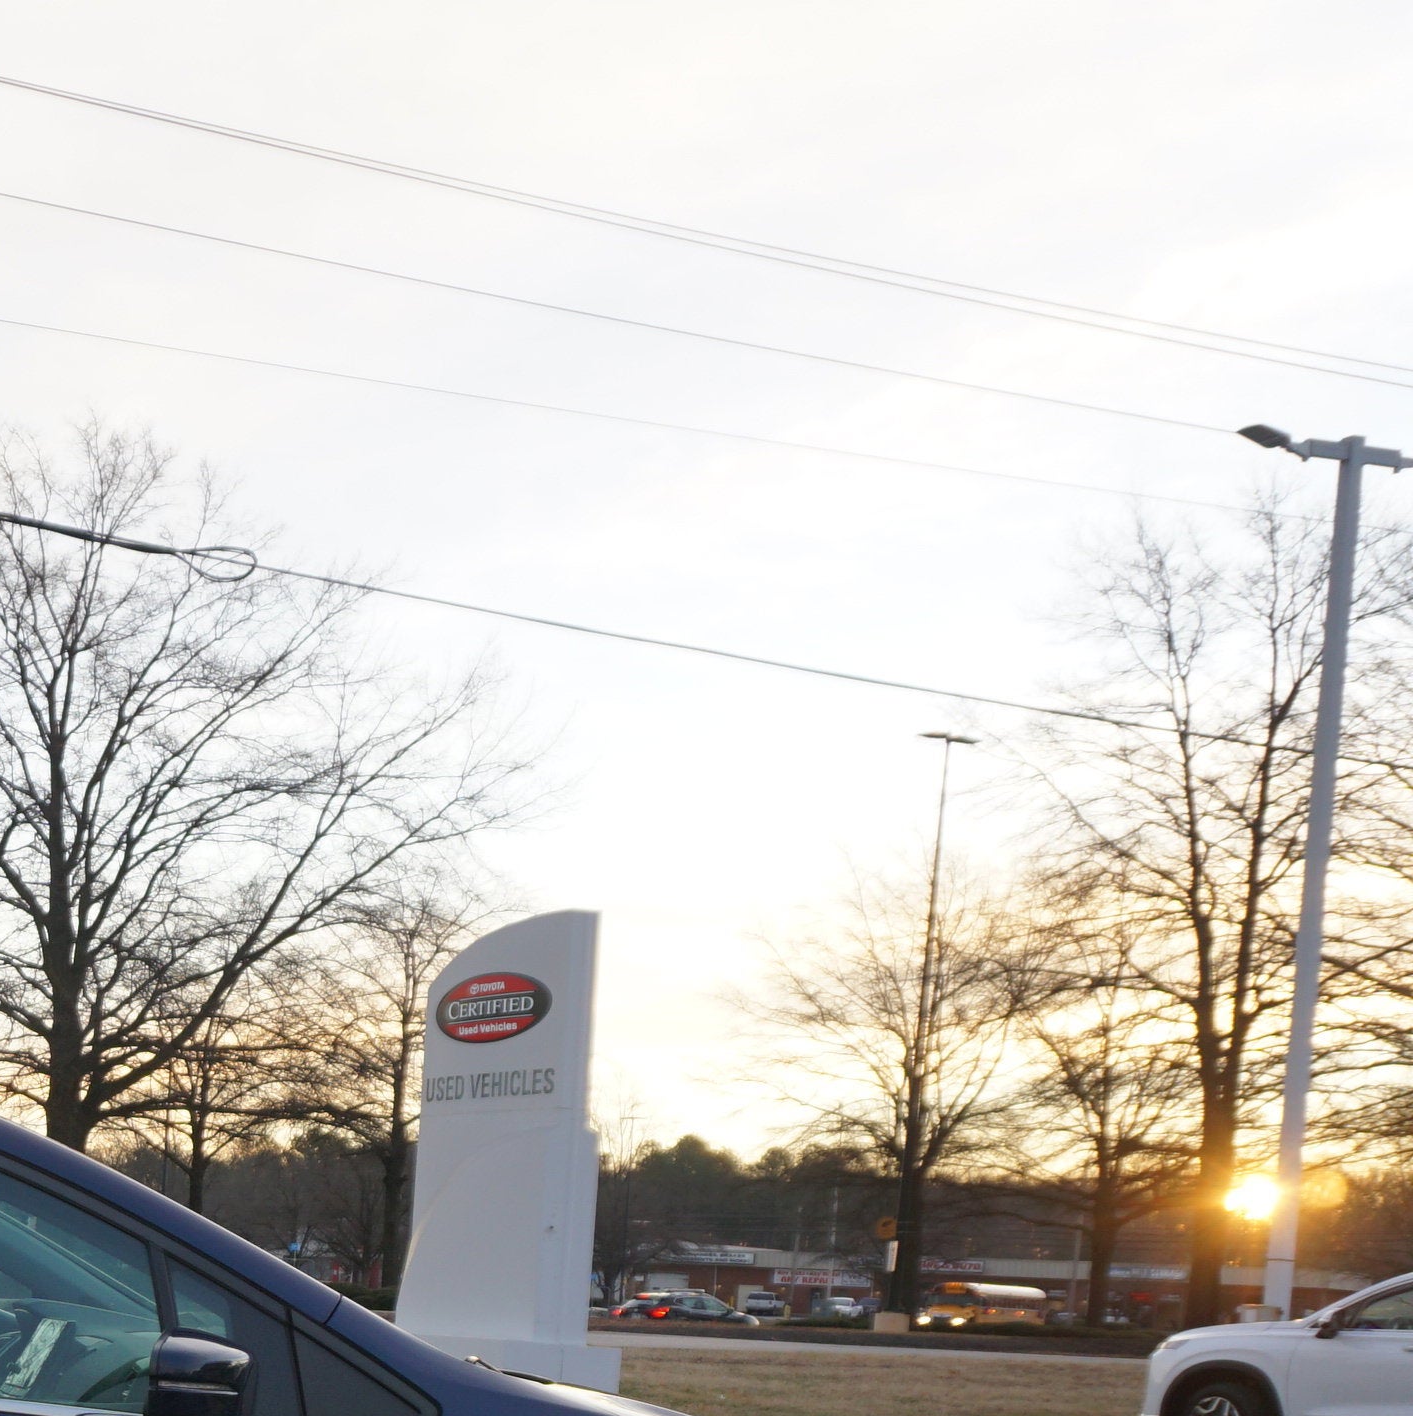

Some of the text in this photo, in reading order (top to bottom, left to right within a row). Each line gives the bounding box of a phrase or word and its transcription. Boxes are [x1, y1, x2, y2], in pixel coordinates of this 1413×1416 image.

[479, 981, 505, 992] TOYOTA
[448, 996, 534, 1020] CERTIFIED
[459, 1021, 518, 1035] Used Vehicles
[426, 1068, 555, 1103] USED VEHICLES
